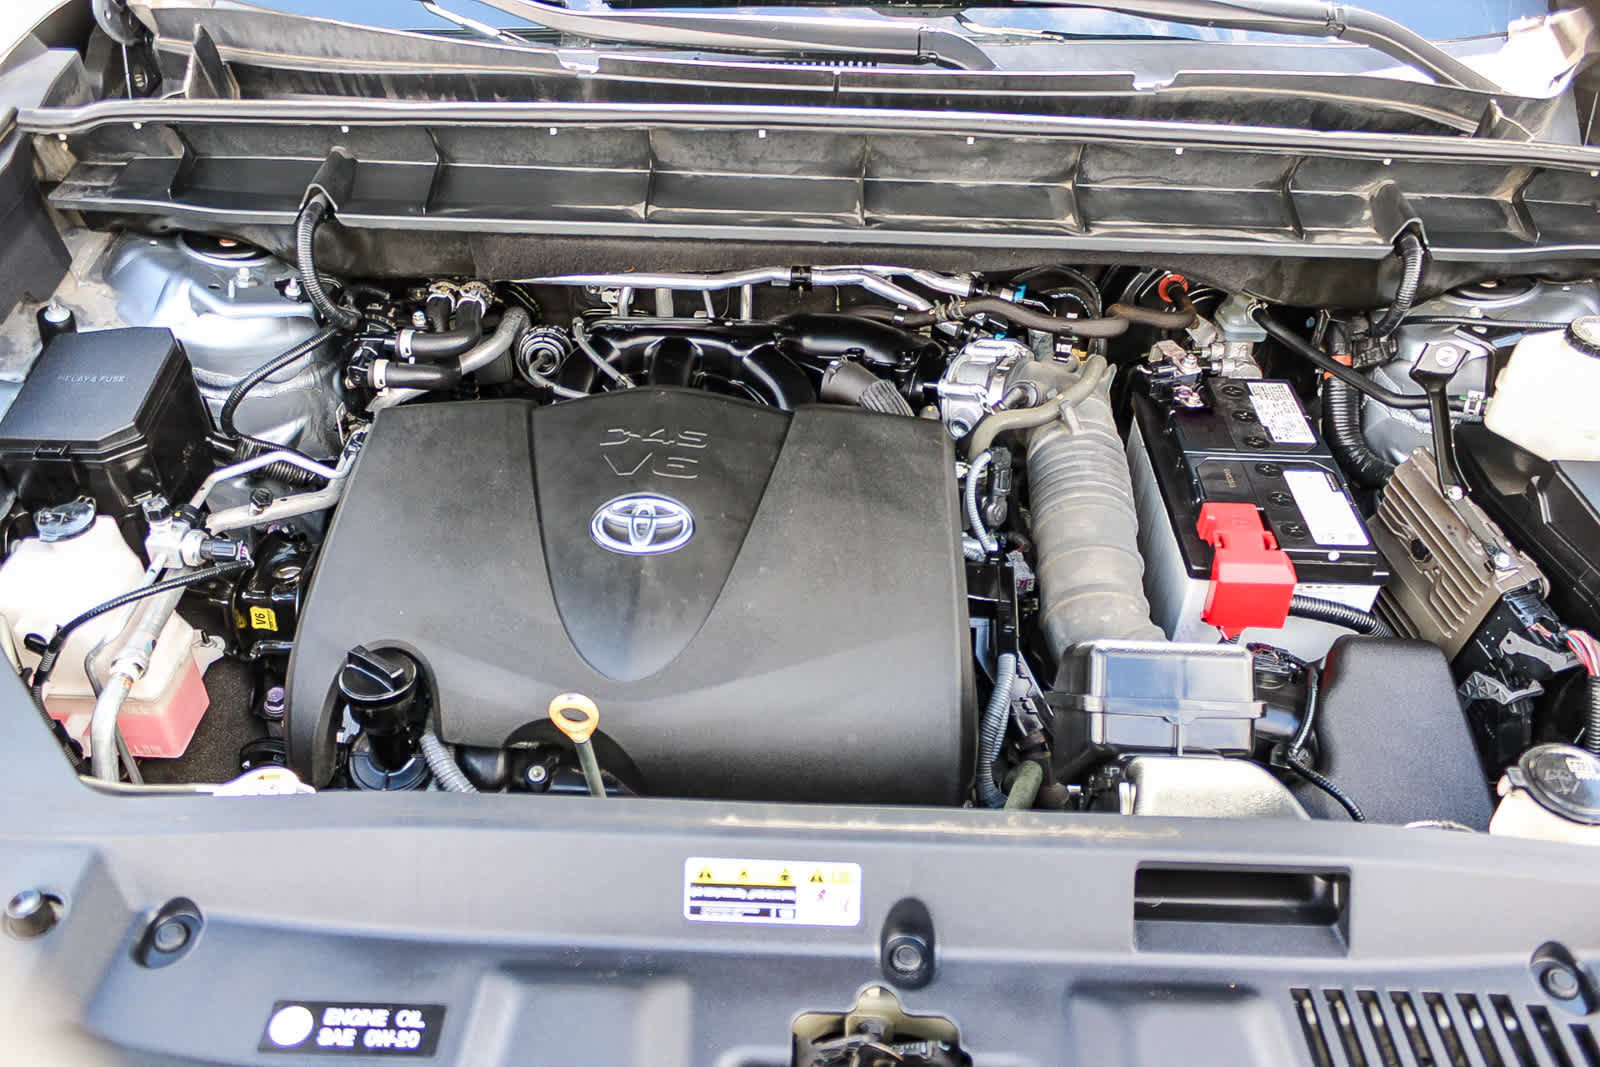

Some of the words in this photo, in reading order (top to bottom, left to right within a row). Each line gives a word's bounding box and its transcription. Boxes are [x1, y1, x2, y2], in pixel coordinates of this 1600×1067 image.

[602, 452, 699, 479] V6
[255, 613, 266, 625] V6
[322, 1007, 389, 1027] ENGINE
[394, 1009, 425, 1028] OIL
[316, 1027, 357, 1046] SAE
